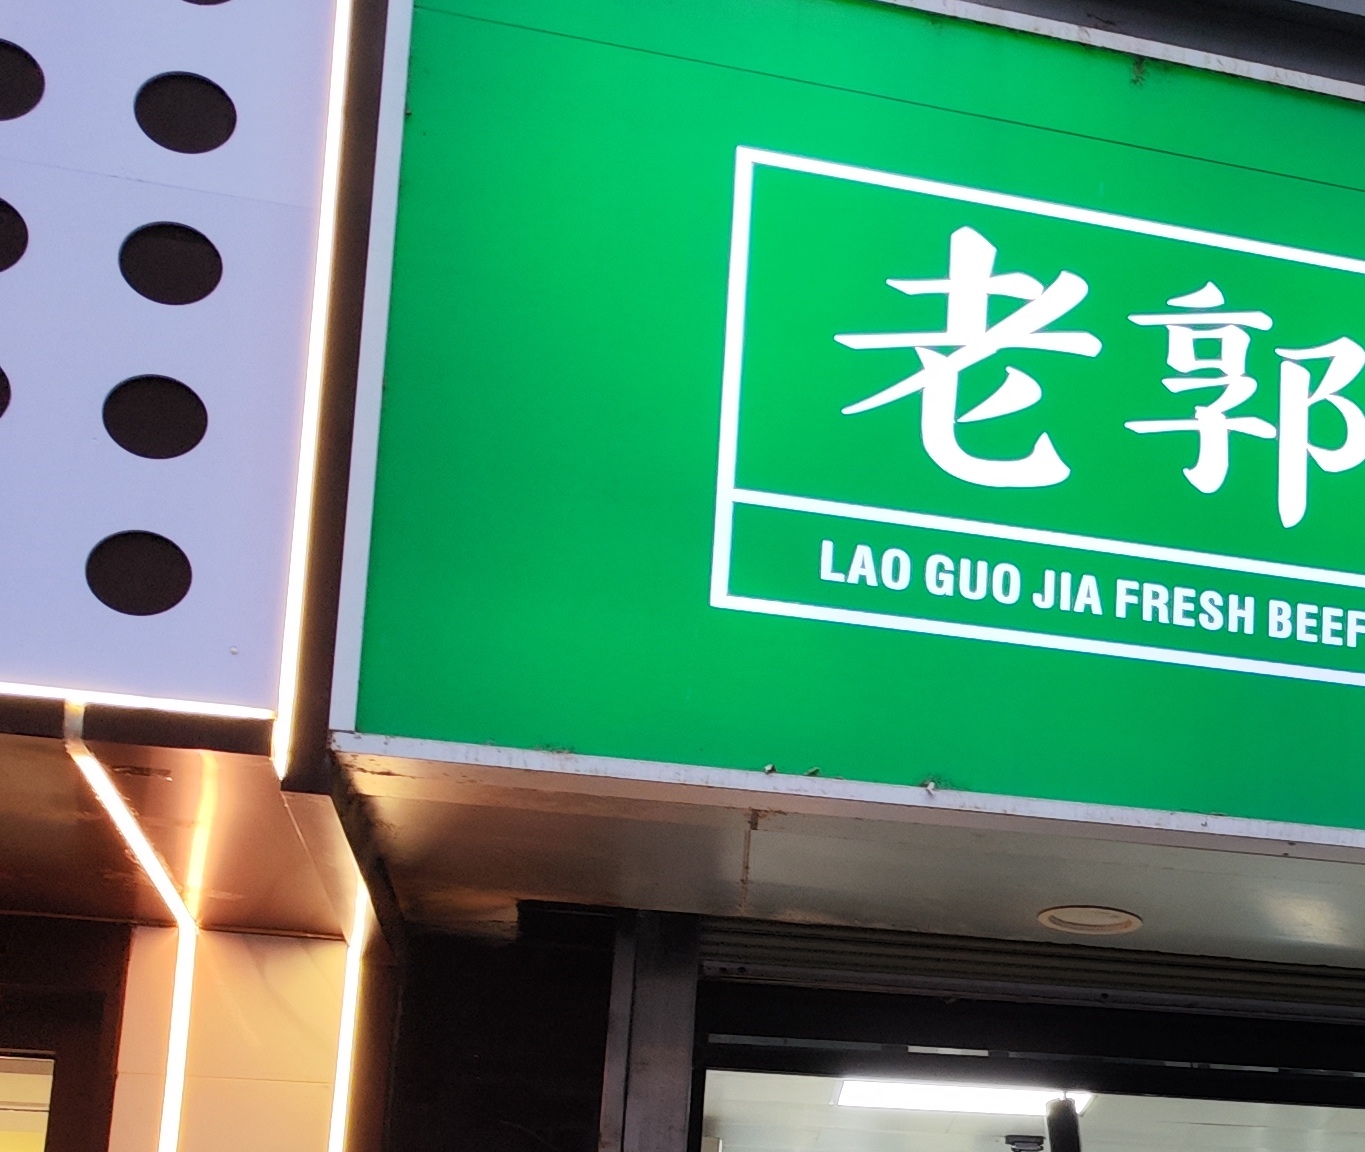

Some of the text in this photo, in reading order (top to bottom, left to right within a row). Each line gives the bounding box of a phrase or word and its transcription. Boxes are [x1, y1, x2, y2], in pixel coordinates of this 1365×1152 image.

[820, 539, 911, 591] LAO
[924, 554, 1021, 605] GUO
[1032, 569, 1103, 615] JIA
[1115, 578, 1255, 635] FRESH
